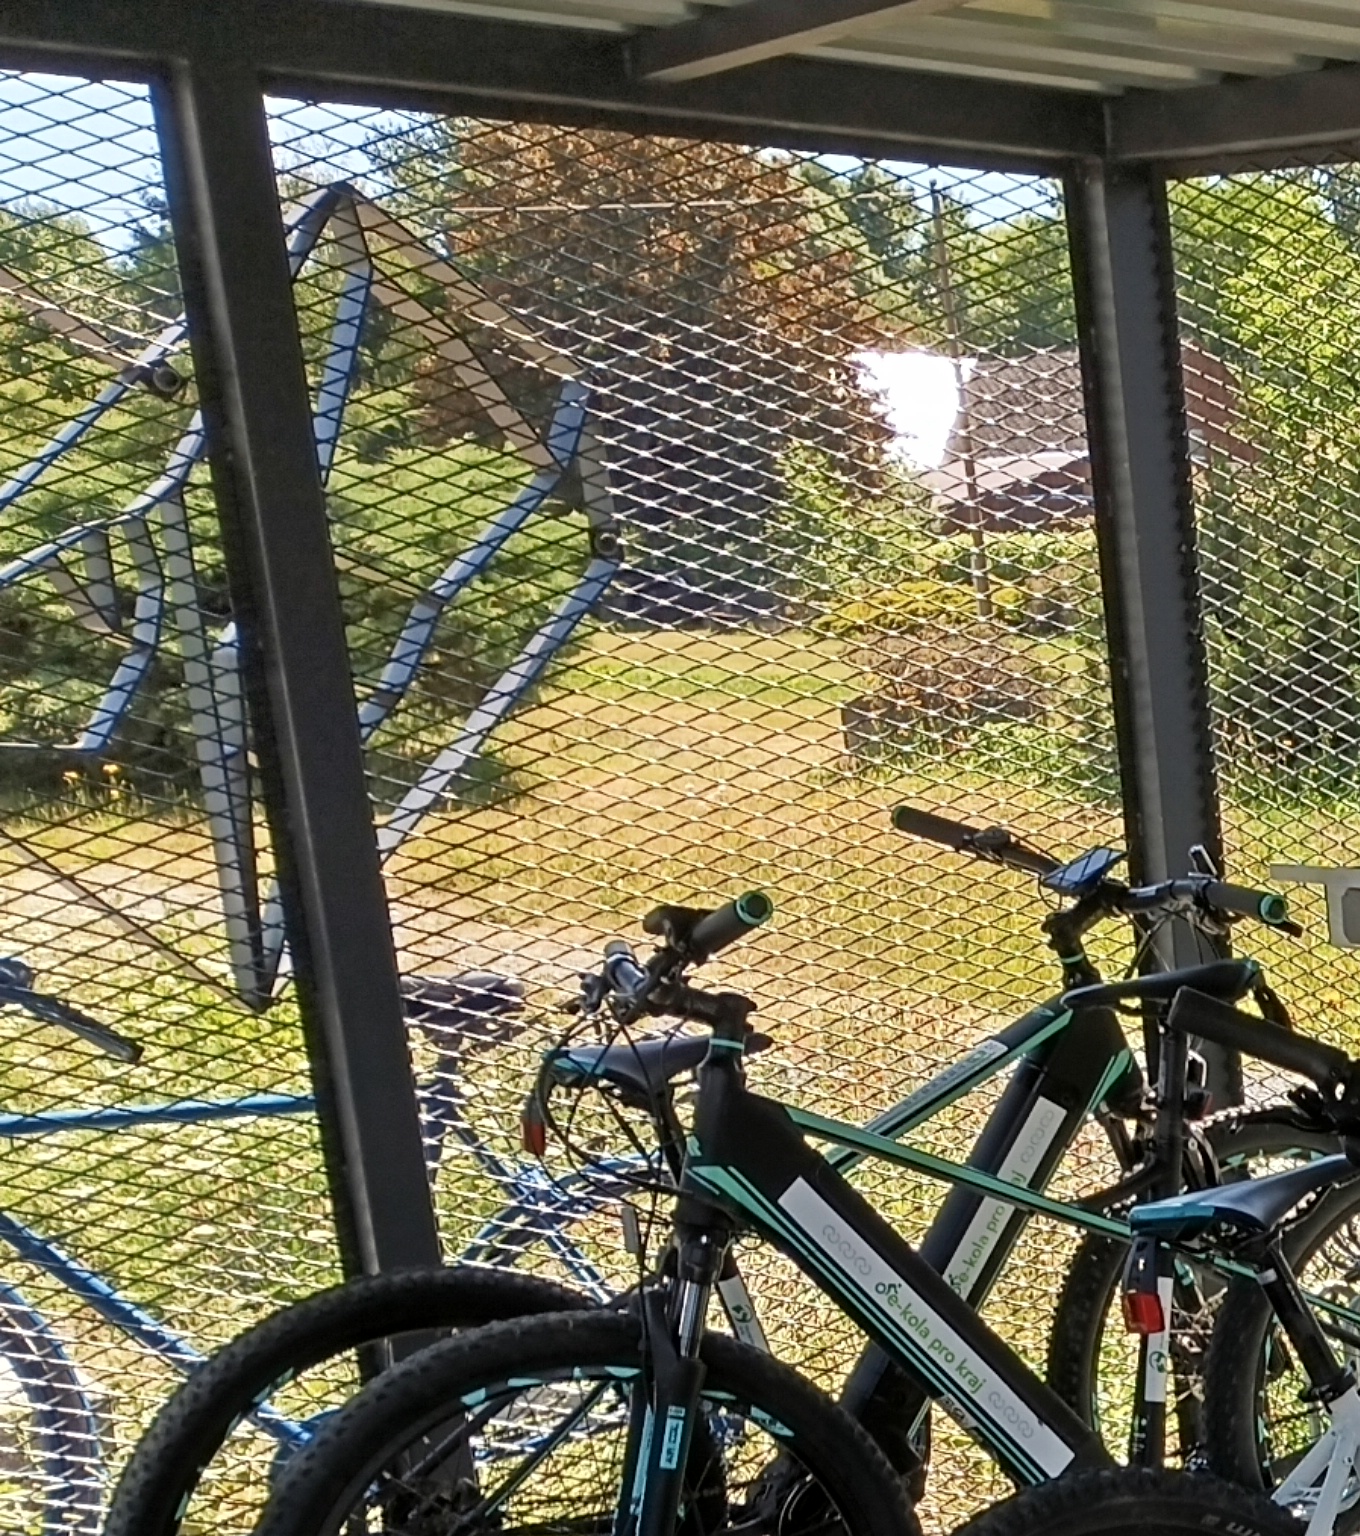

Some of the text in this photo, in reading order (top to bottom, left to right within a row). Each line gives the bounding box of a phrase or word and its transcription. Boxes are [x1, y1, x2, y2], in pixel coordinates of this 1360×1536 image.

[987, 1205, 1006, 1234] pro
[886, 1294, 988, 1395] e-kola pro kraj
